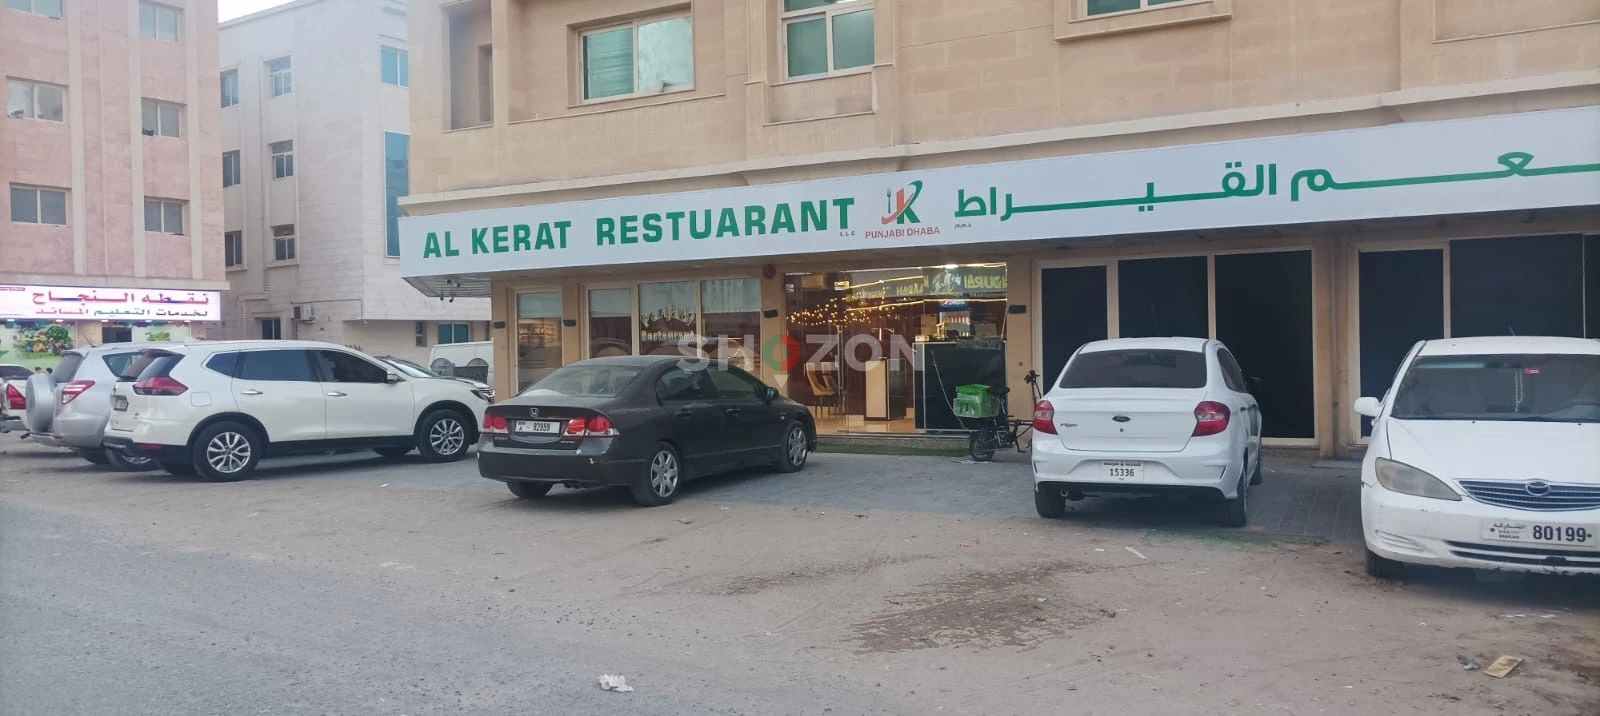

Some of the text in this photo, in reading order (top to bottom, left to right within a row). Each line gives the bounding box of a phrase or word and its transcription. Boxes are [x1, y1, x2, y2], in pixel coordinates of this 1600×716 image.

[954, 161, 1278, 222] القيراط
[423, 231, 460, 259] AL
[471, 220, 572, 255] KERAT
[596, 197, 855, 246] RESTUARANT
[865, 226, 941, 240] PUNJABI DHABA
[32, 289, 134, 305] النجاح
[93, 307, 150, 317] التعليم
[1109, 468, 1135, 477] 15336
[1532, 525, 1587, 543] 80199
